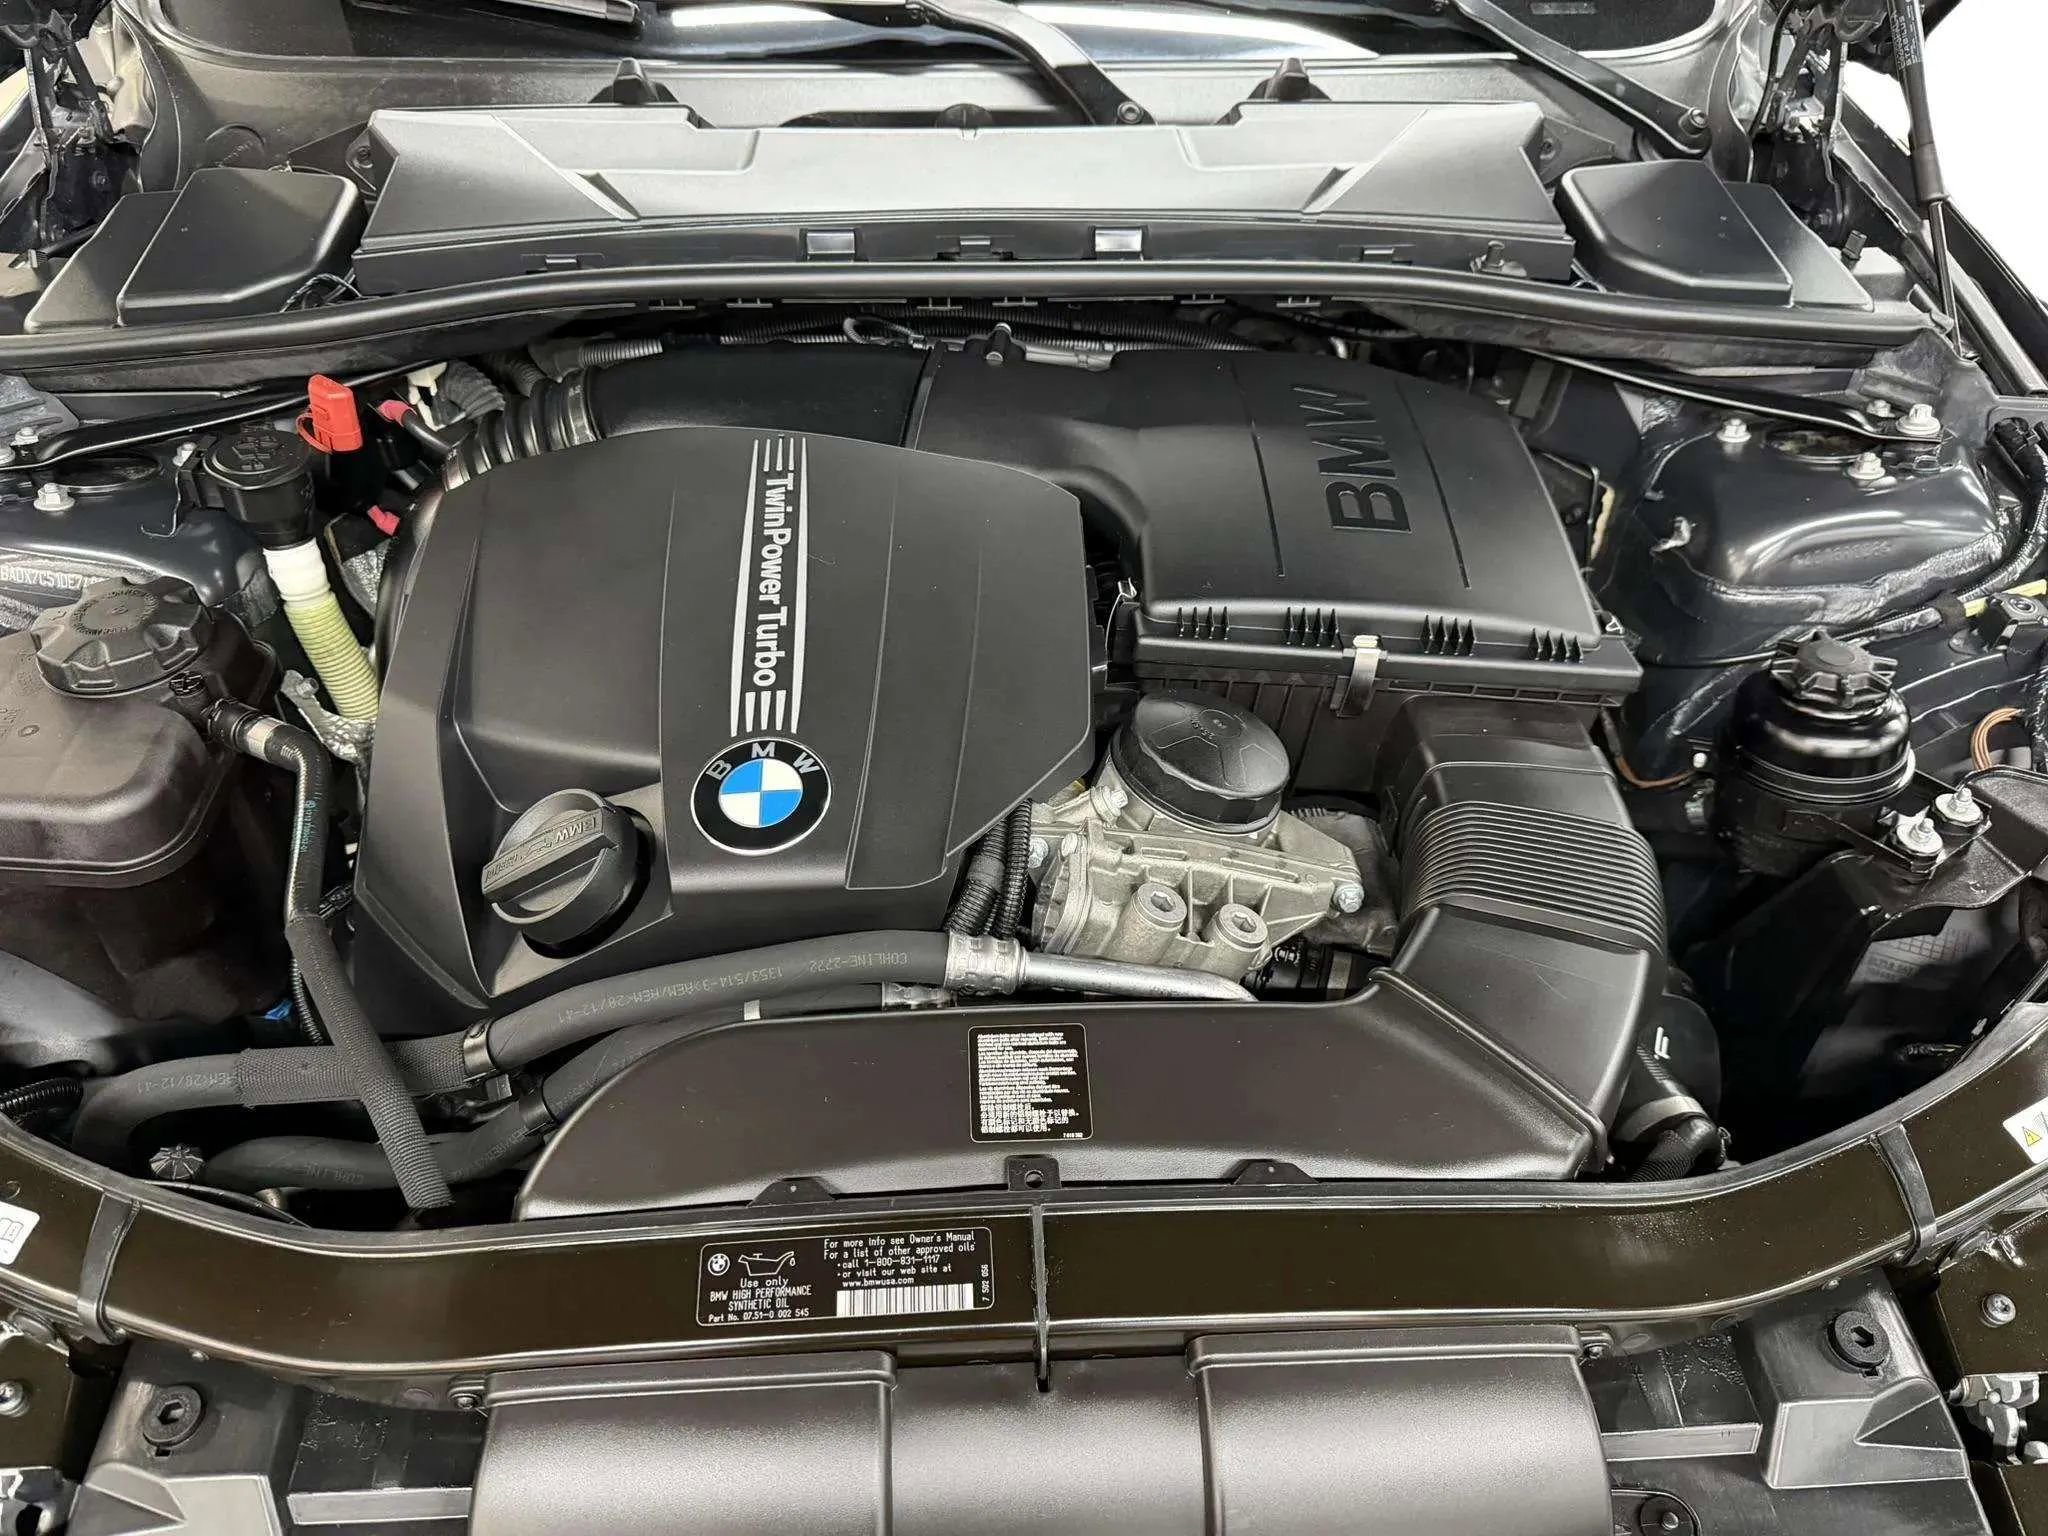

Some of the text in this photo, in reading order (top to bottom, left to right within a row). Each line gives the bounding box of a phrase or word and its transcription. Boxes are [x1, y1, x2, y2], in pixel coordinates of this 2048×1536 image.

[1291, 384, 1412, 534] BMW
[753, 473, 794, 687] TwinPower Turbo
[705, 741, 821, 781] BMW
[824, 1230, 975, 1249] For more info see Owner's Manual
[824, 1250, 839, 1260] For
[853, 1247, 869, 1258] list
[874, 1247, 884, 1257] of
[888, 1245, 911, 1256] other
[915, 1241, 954, 1254] approved
[842, 1254, 940, 1269] call 1-800-831-1117
[842, 1262, 952, 1279] or visit our web site at
[740, 1275, 789, 1289] Use only
[842, 1276, 915, 1288] www.bmwusa.com
[709, 1285, 812, 1303] BMW HIGH PERFORMANCE
[728, 1297, 790, 1312] SYNTHETIC OIL
[708, 1307, 810, 1323] Part No. 07.51-0 002 545
